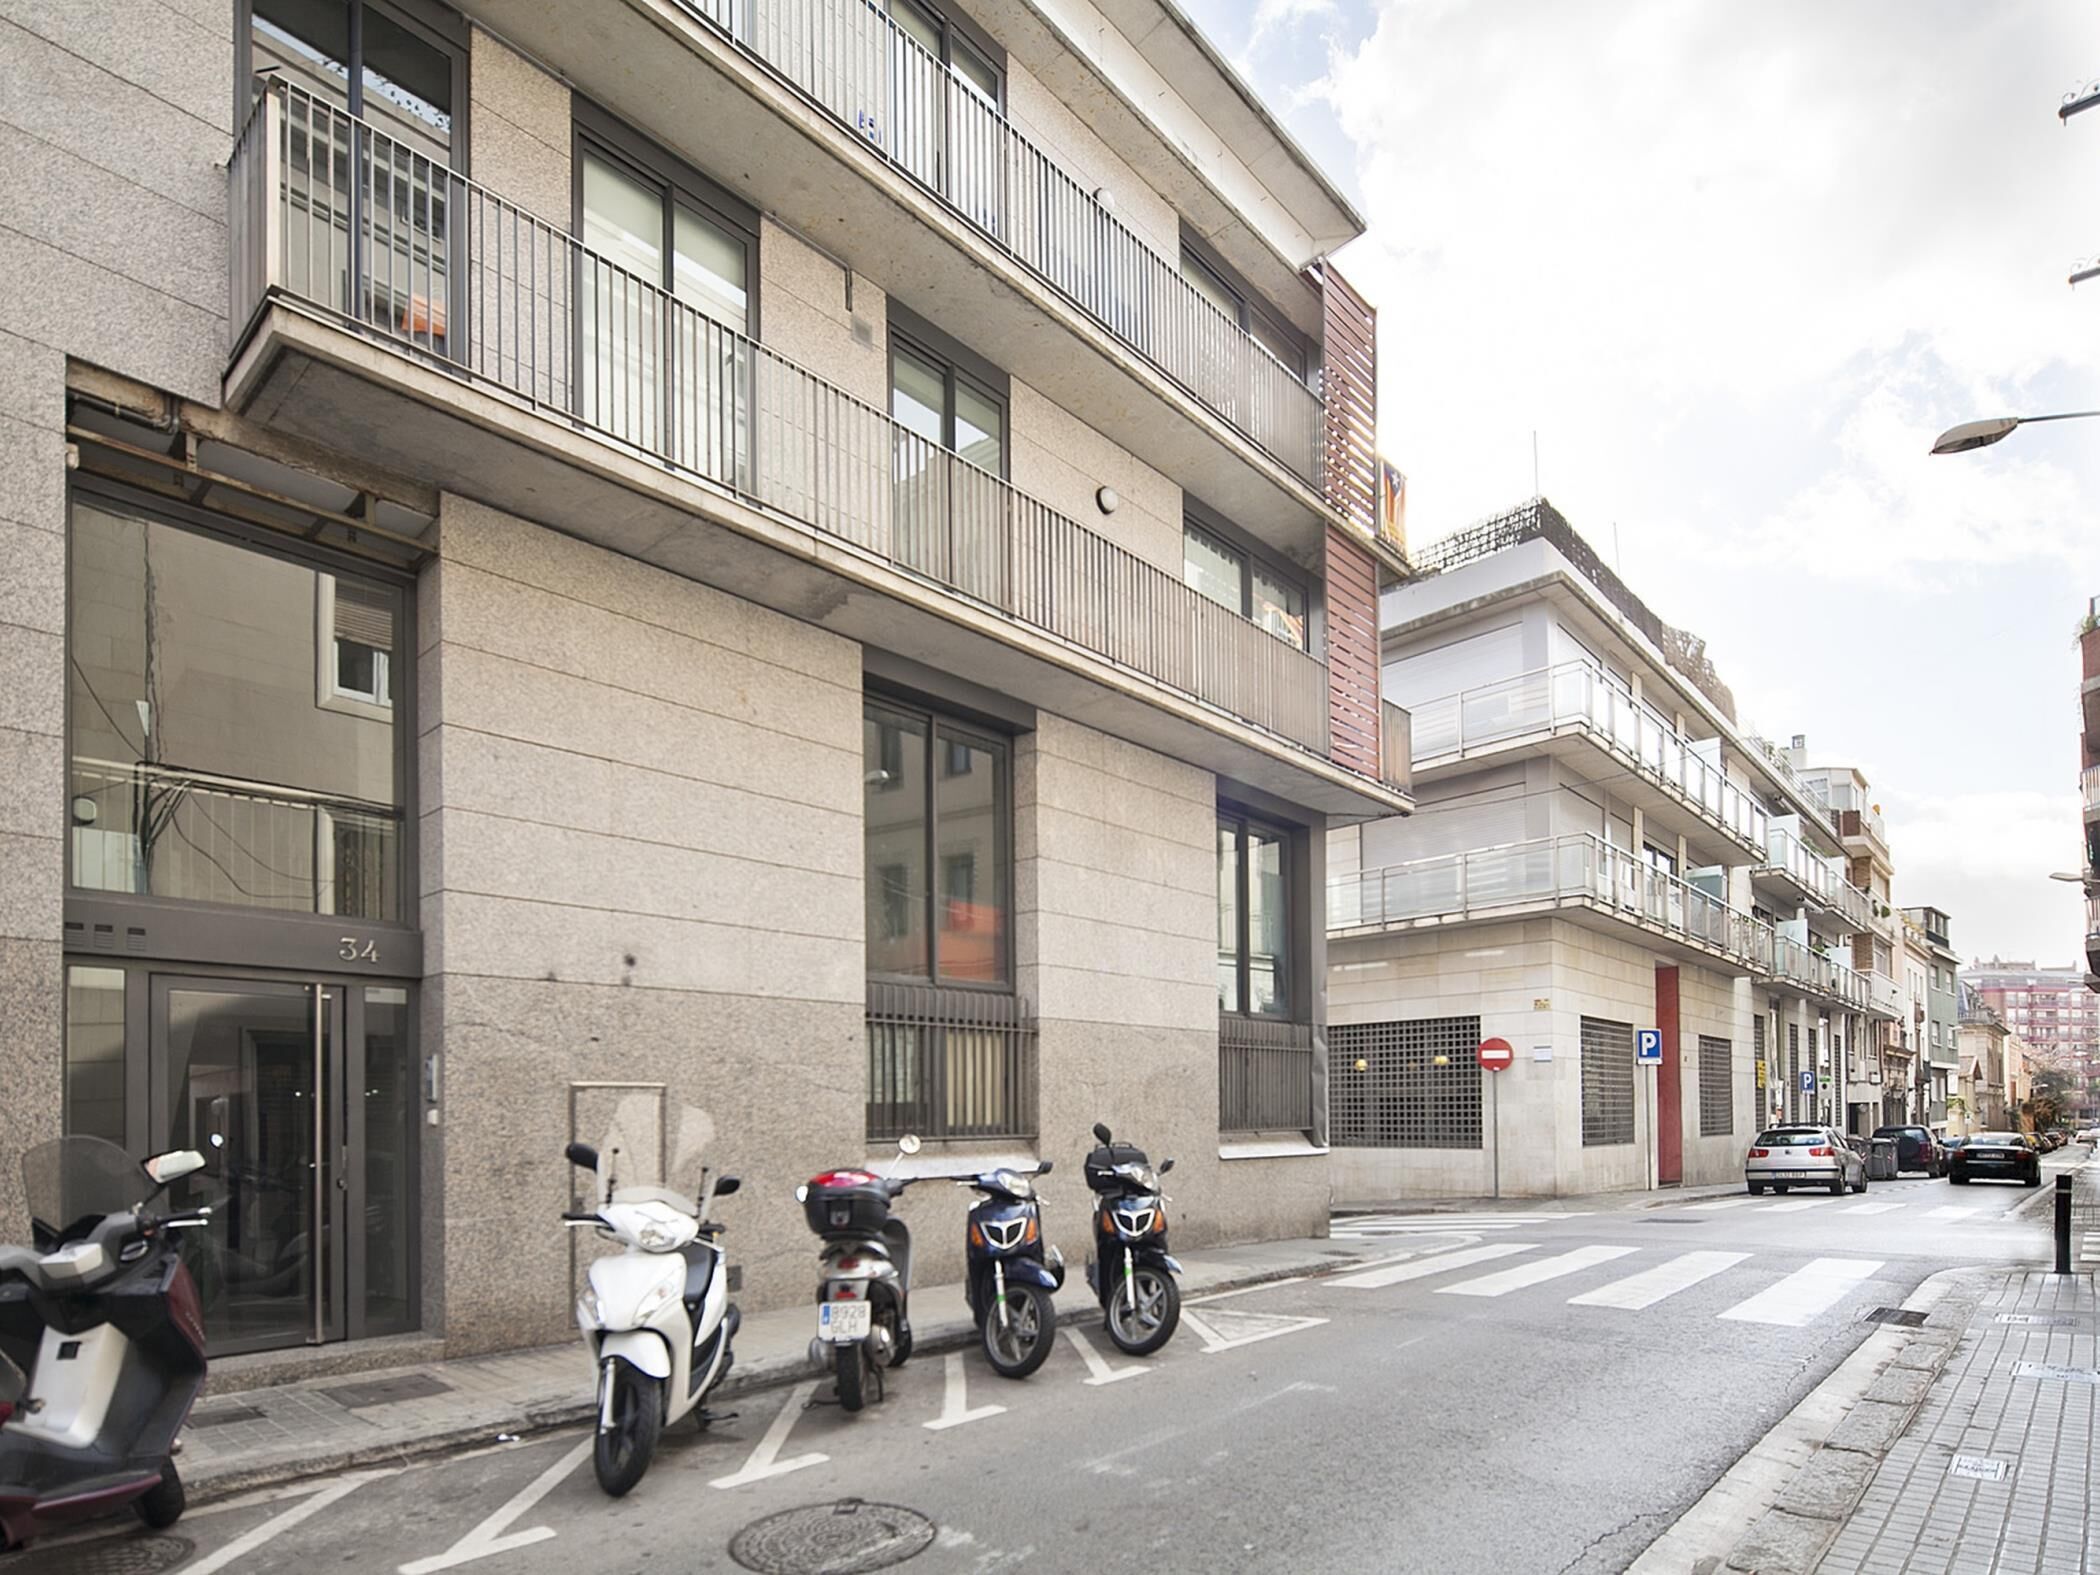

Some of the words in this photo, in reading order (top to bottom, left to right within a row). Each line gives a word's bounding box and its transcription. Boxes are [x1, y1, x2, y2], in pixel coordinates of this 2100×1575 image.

[339, 937, 381, 963] 34
[1641, 1032, 1657, 1056] P
[1803, 1073, 1812, 1089] P
